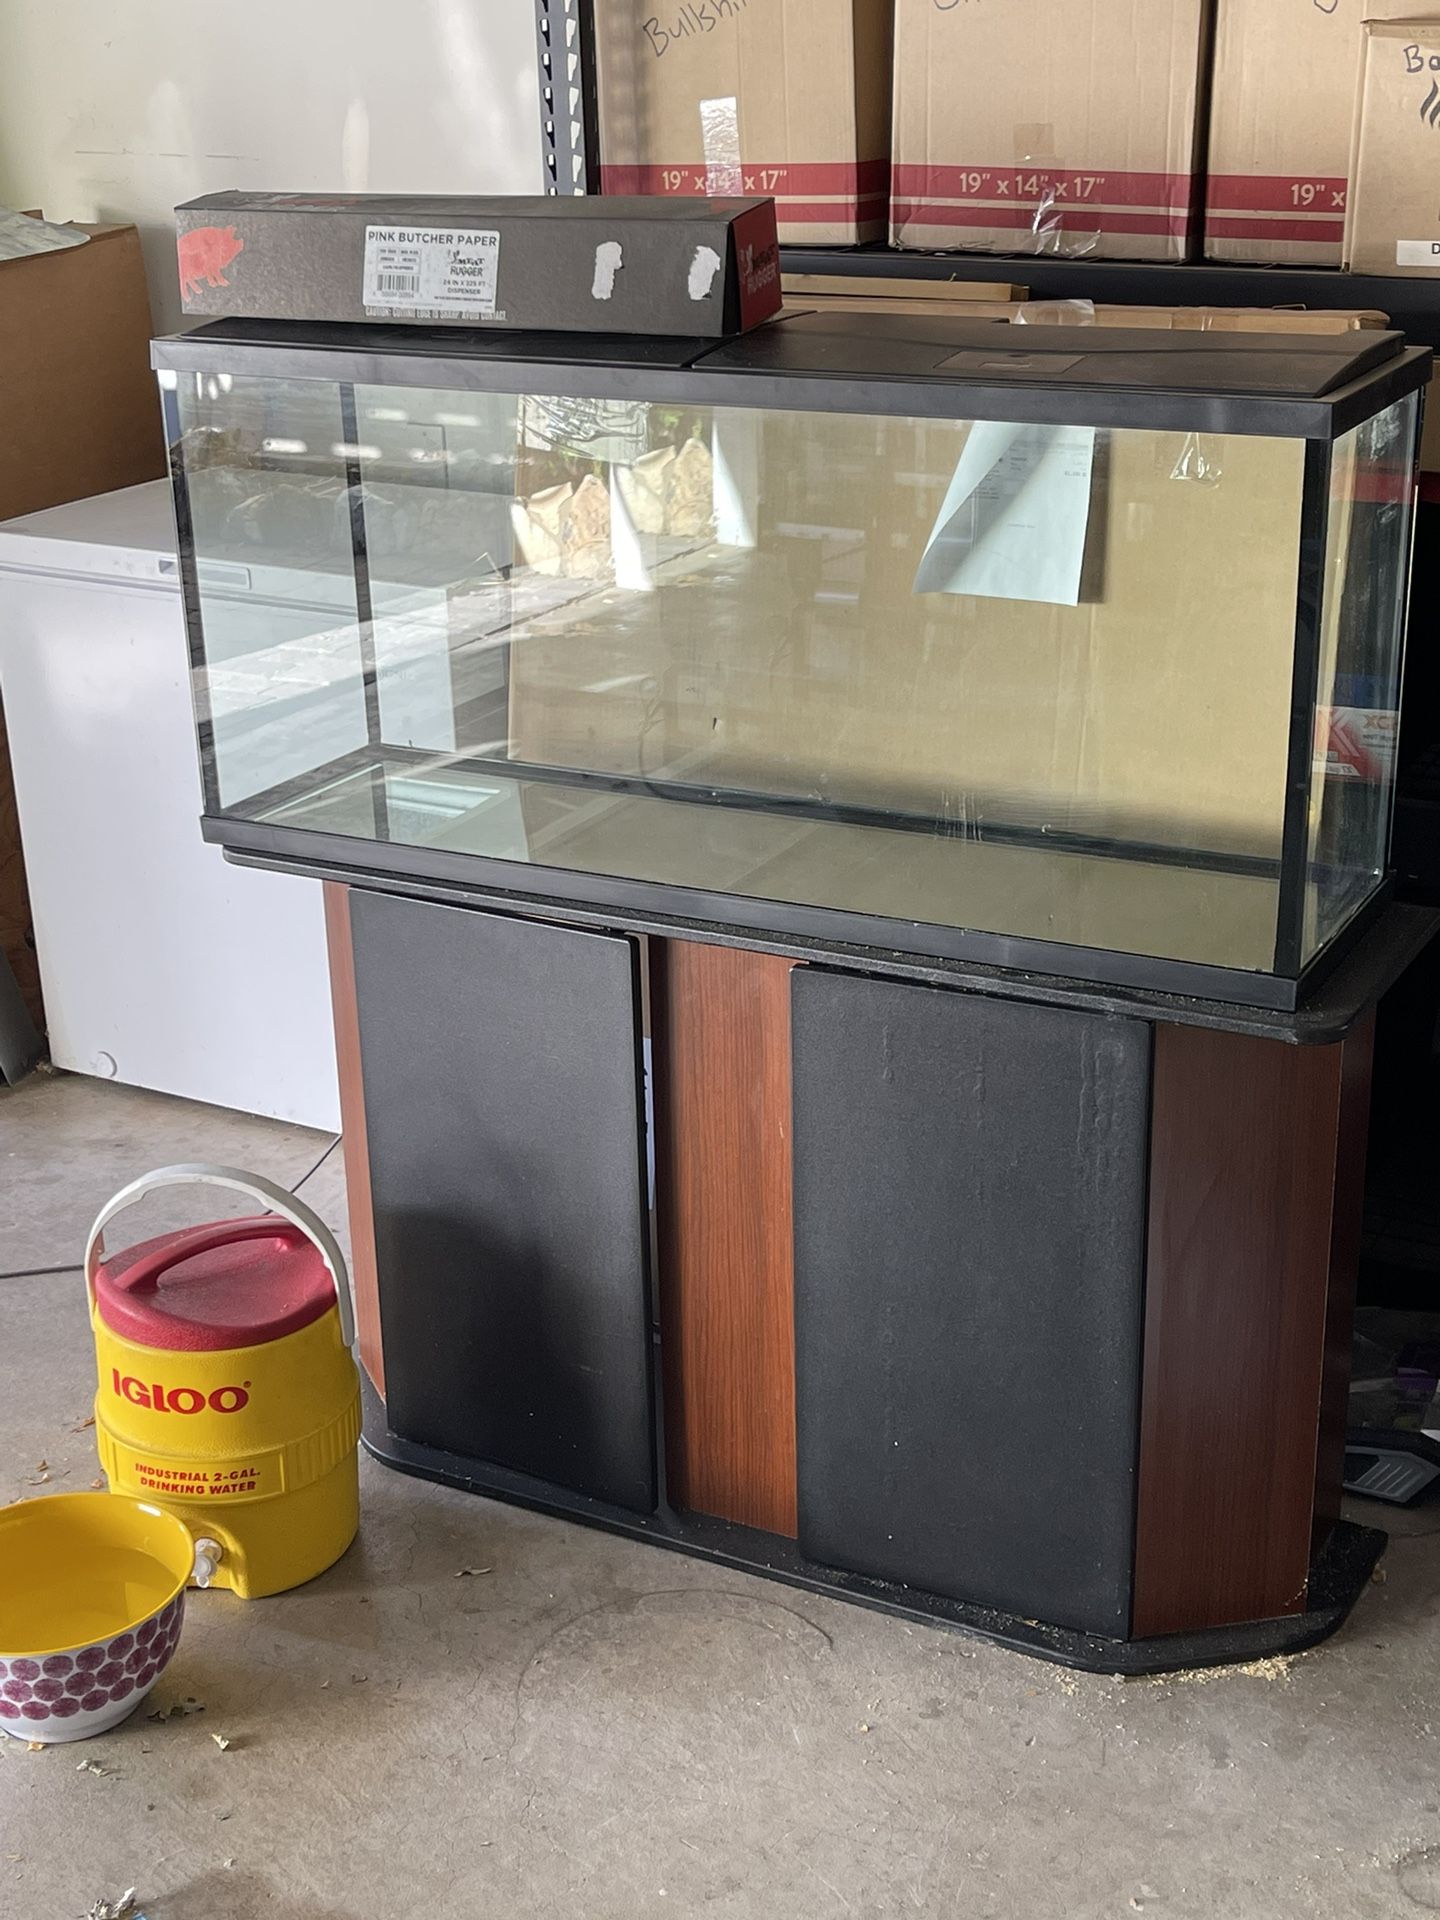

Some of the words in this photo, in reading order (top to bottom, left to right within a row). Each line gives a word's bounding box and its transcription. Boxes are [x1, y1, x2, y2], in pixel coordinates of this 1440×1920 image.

[643, 0, 747, 57] Bullshi
[662, 170, 689, 190] 19"
[694, 176, 705, 190] x
[744, 176, 755, 190] x
[760, 169, 787, 190] 17"
[960, 172, 991, 193] 19"
[996, 180, 1009, 194] x
[1015, 174, 1049, 195] 14"
[1055, 182, 1067, 197] x
[1073, 176, 1105, 198] 17"
[1291, 183, 1326, 206] 19"
[1331, 191, 1346, 207] x
[368, 230, 396, 242] PINK
[398, 232, 454, 245] BUTCHER
[457, 235, 497, 247] PAPER
[112, 1368, 249, 1415] IGLOO
[135, 1463, 209, 1482] INDUSTRIAL
[214, 1467, 261, 1482] 2-GAL.
[140, 1476, 205, 1494] DRINKING
[209, 1480, 256, 1495] WATER
